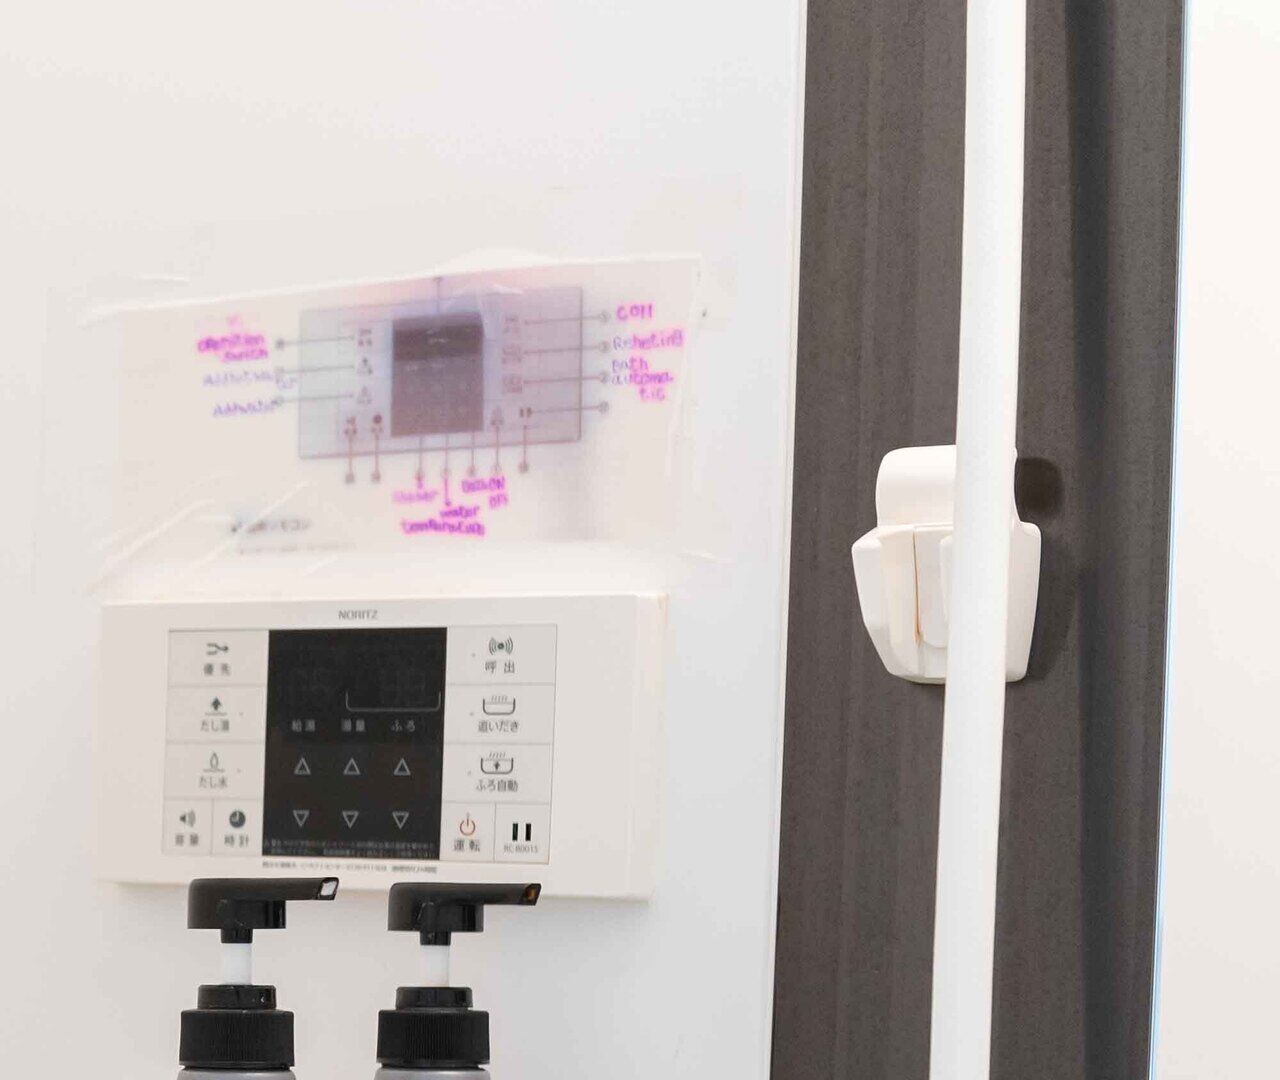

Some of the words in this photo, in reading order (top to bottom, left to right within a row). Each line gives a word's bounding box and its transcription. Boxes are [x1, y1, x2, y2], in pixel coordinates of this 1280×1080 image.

[337, 610, 378, 621] NORITZ
[485, 661, 515, 674] 呼出
[478, 720, 519, 733] 追いだき
[476, 780, 518, 792] ふろ自動
